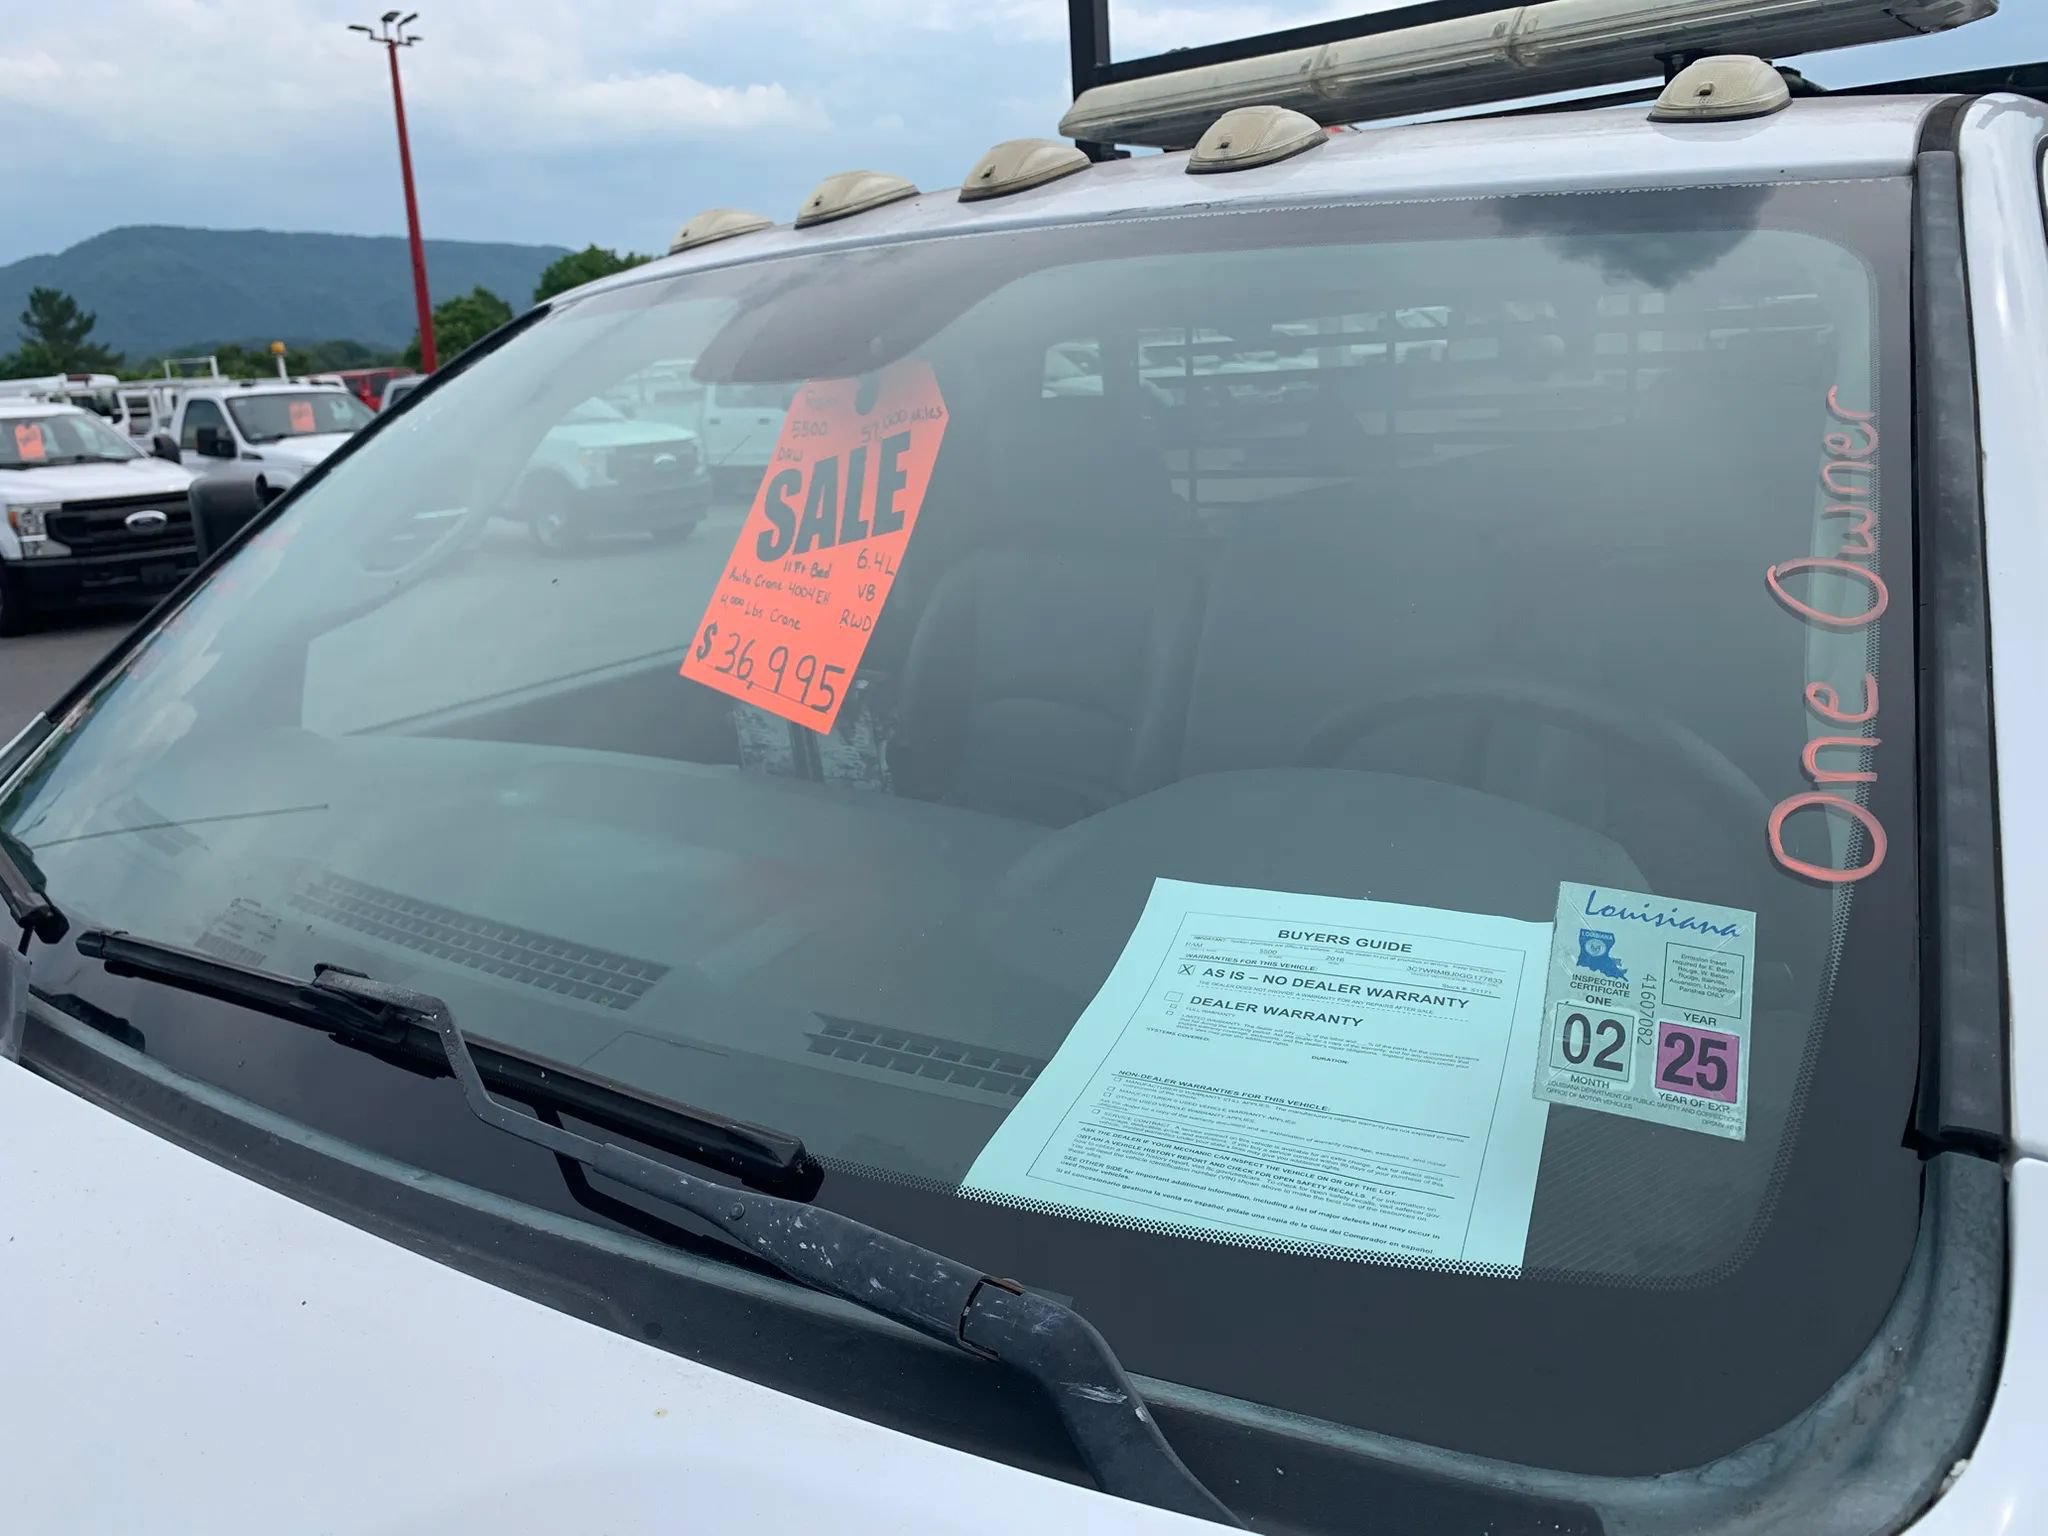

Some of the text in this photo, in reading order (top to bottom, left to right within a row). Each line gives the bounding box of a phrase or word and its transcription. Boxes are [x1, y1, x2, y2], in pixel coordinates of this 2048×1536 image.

[756, 430, 911, 562] SALE
[728, 567, 751, 584] Auto
[755, 574, 783, 591] Crane
[858, 583, 875, 601] V8
[770, 609, 800, 630] Crane
[840, 609, 872, 632] RWD
[1766, 384, 1889, 883] One Owner
[1584, 888, 1740, 940] Louisiana
[1277, 929, 1413, 952] BUYERS GUIDE
[1184, 952, 1239, 963] WARRANTIES
[1202, 967, 1227, 978] AS
[1228, 970, 1246, 980] IS
[1261, 974, 1289, 985] NO
[1291, 977, 1362, 994] DEALER
[1364, 986, 1469, 1008] WARRANTY
[1569, 980, 1630, 997] CERTIFICATE
[1572, 973, 1629, 989] INSPECTION
[1584, 994, 1612, 1007] ONE
[1706, 990, 1723, 998] ONLY
[1189, 996, 1363, 1027] DEALER WARRANTY
[1636, 973, 1657, 1046] 41607082
[1683, 1012, 1716, 1026] YEAR
[1562, 1013, 1626, 1072] 02
[1661, 1032, 1728, 1092] 25
[1117, 1070, 1177, 1084] NON-DEALER
[1177, 1081, 1240, 1095] WARRANTIES
[1241, 1091, 1261, 1099] FOR
[1263, 1095, 1284, 1103] THIS
[1570, 1074, 1609, 1089] MONTH
[1578, 1093, 1601, 1102] MOTOR
[1658, 1092, 1686, 1104] YEAR
[1689, 1098, 1704, 1108] OF
[1110, 1140, 1142, 1150] VEHICLE
[1142, 1147, 1175, 1158] HISTORY
[1175, 1154, 1207, 1164] REPORT
[1272, 1174, 1295, 1183] OPEN
[1295, 1179, 1327, 1190] SAFETY
[1111, 1133, 1142, 1142] DEALER
[1150, 1141, 1172, 1149] YOUR
[1172, 1145, 1212, 1157] MECHANIC
[1280, 1168, 1315, 1179] VEHICLE
[1078, 1158, 1105, 1167] OTHER
[1134, 1171, 1170, 1182] important
[1170, 1178, 1207, 1190] additional
[1252, 1196, 1288, 1208] including
[1318, 1211, 1340, 1220] major
[1341, 1216, 1370, 1225] defects
[1407, 1229, 1429, 1237] occur
